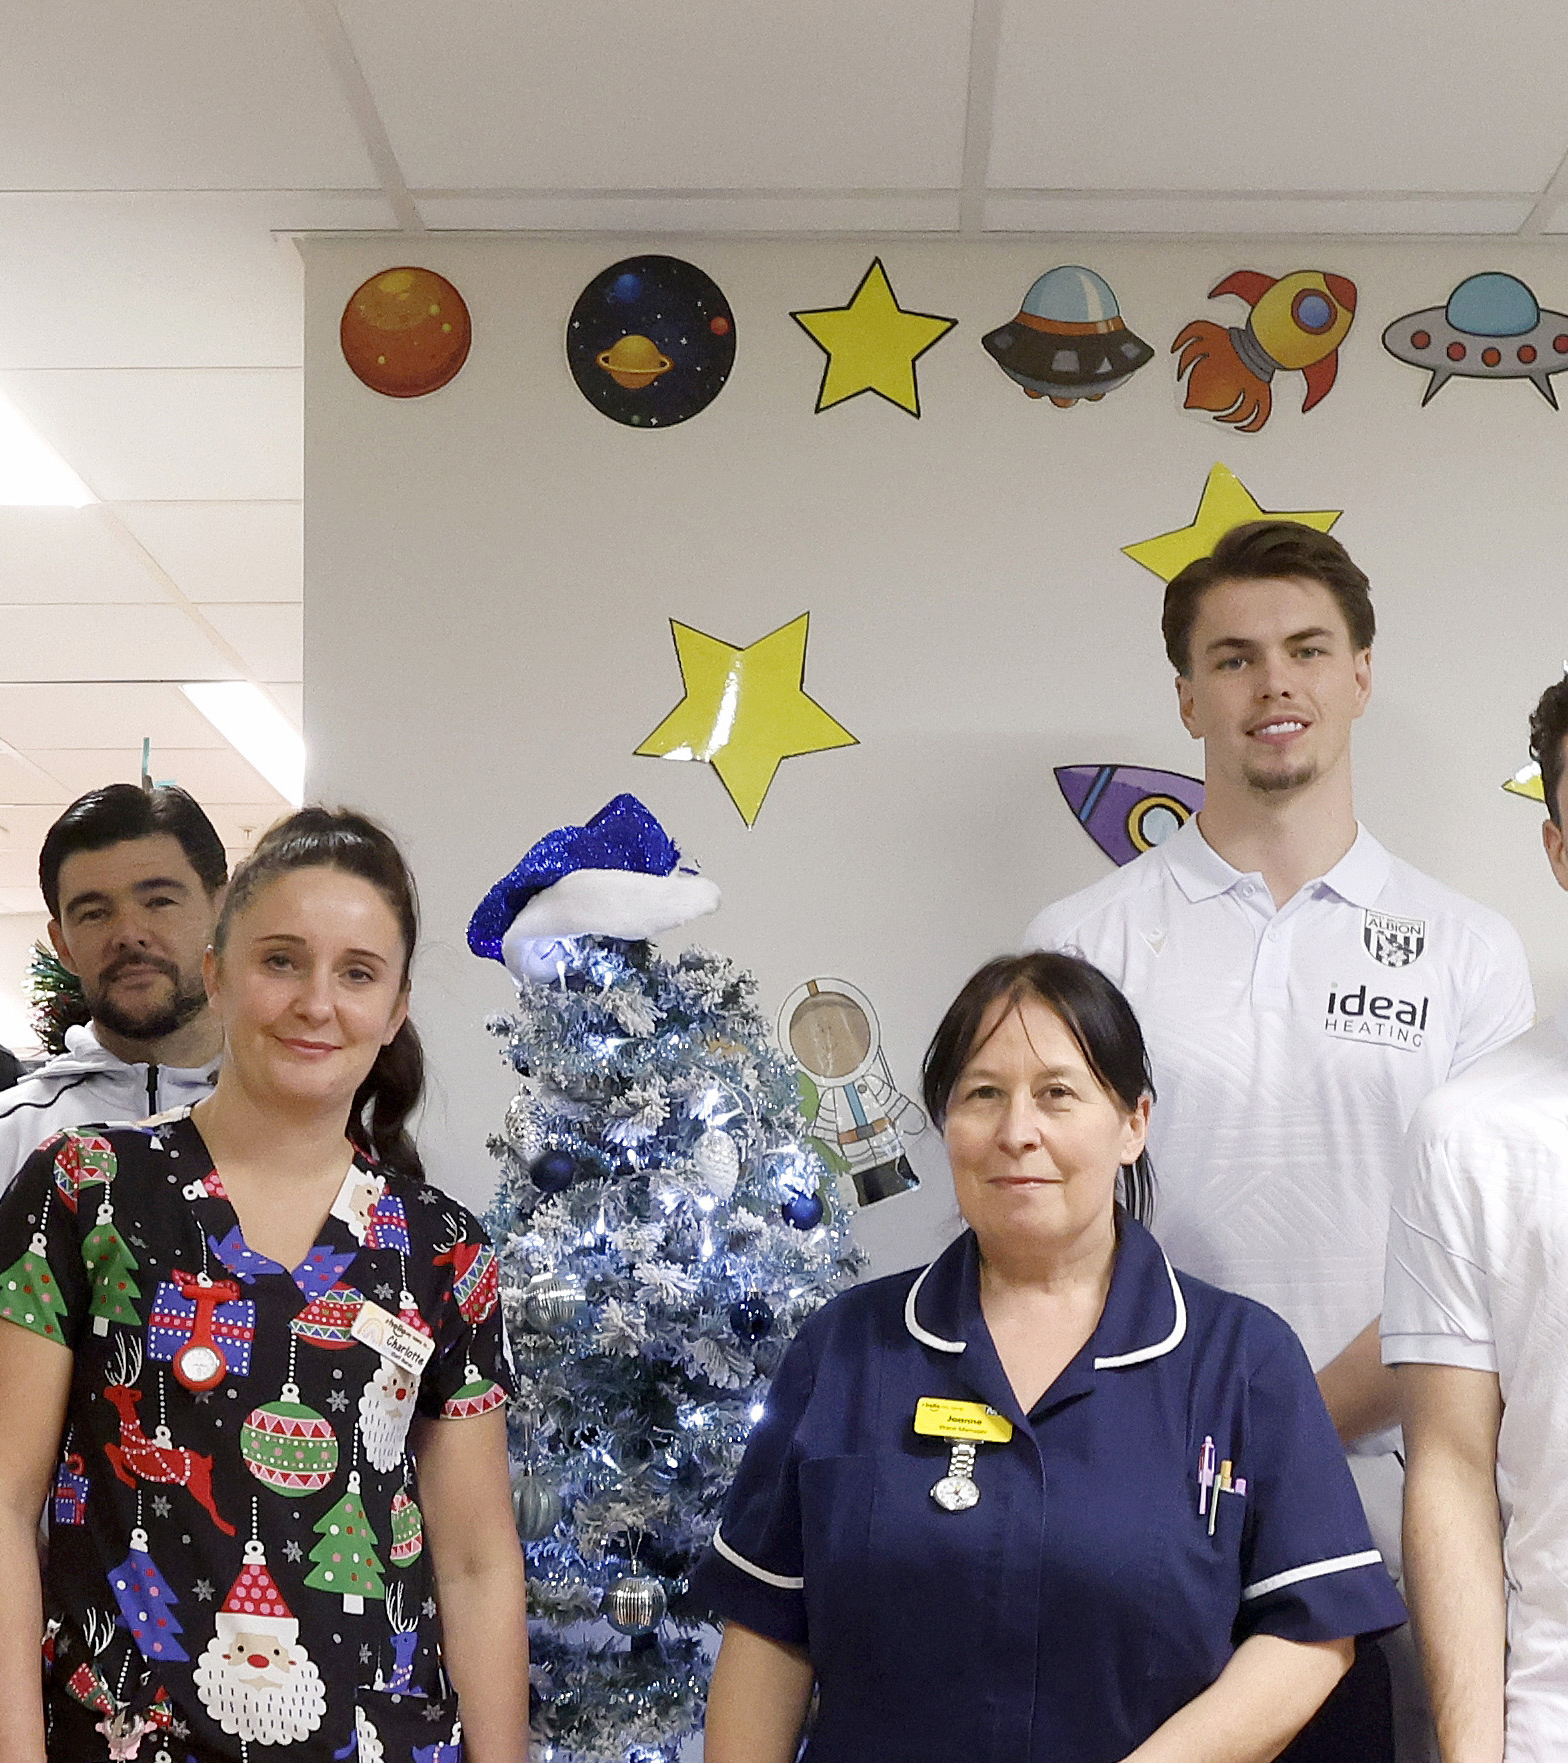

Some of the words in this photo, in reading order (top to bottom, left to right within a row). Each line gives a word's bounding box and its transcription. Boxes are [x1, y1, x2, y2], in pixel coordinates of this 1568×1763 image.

[1368, 918, 1421, 935] ALBION
[1327, 981, 1429, 1031] ideal
[1325, 1018, 1423, 1047] HEATING
[386, 1335, 424, 1366] Charlotte
